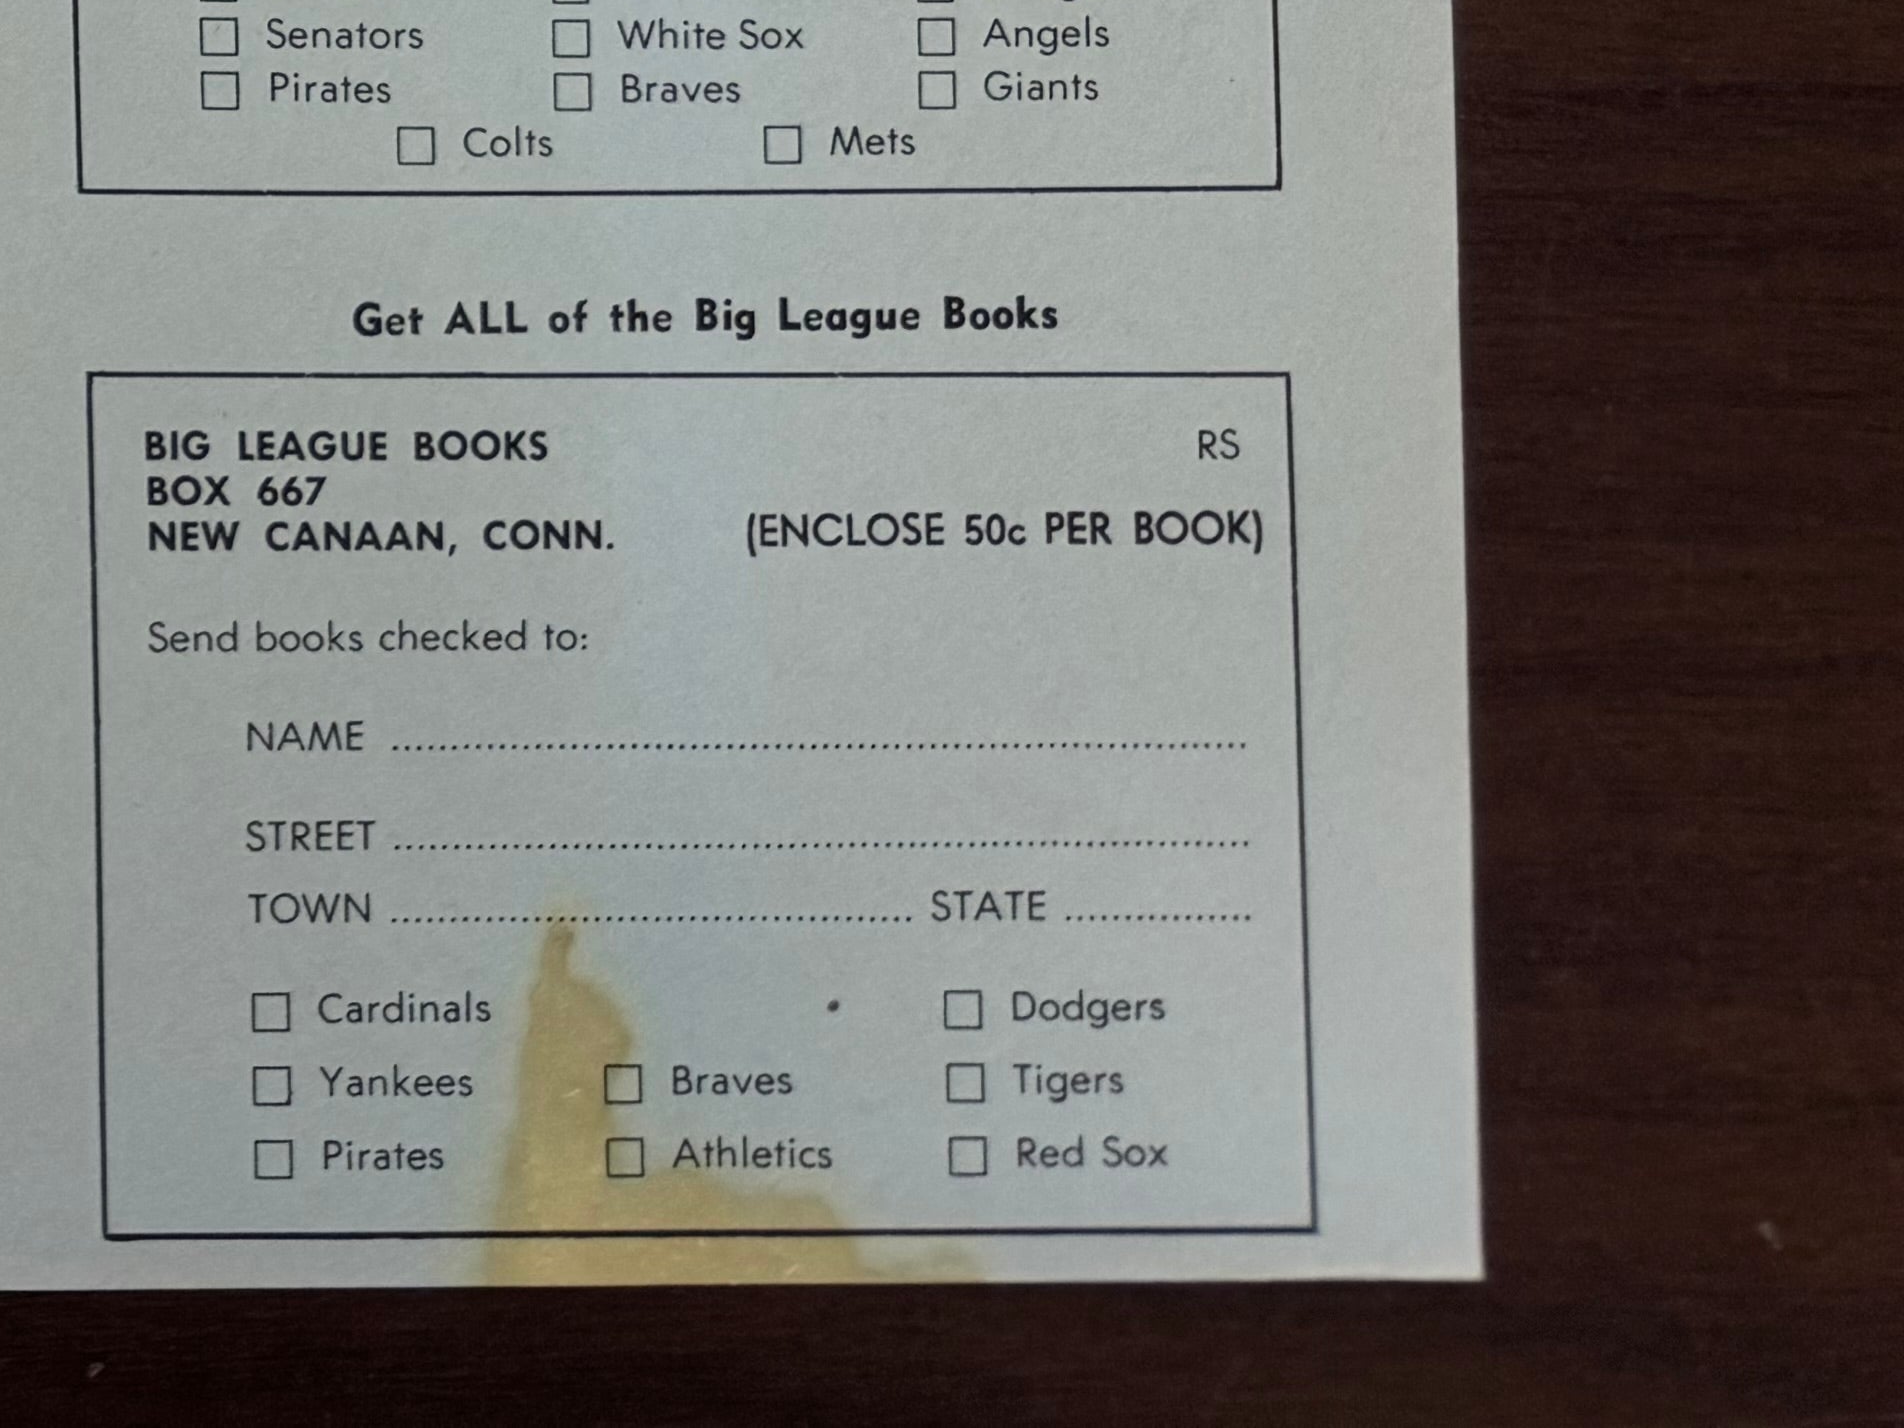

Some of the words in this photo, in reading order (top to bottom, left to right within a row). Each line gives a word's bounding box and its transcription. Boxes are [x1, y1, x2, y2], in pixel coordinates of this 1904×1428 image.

[266, 17, 424, 50] Senators
[616, 16, 727, 51] White
[738, 18, 805, 51] Sox
[982, 14, 1110, 57] Angels
[269, 71, 392, 104] Pirates
[621, 72, 742, 104] Braves
[983, 69, 1100, 102] Giants
[462, 124, 554, 159] Colts
[829, 125, 917, 157] Mets
[352, 300, 425, 338] Get
[443, 299, 529, 336] ALL
[547, 298, 589, 335] of
[608, 297, 673, 334] the
[694, 296, 757, 342] Big
[778, 296, 921, 340] League
[943, 294, 1059, 331] Books
[144, 429, 211, 462] BIG
[237, 429, 388, 462] LEAGUE
[413, 429, 549, 462] BOOKS
[1197, 427, 1241, 461] RS
[146, 474, 232, 507] BOX
[256, 475, 328, 508] 667
[148, 520, 241, 553] NEW
[264, 520, 458, 558] CANAAN,
[482, 518, 615, 552] CONN.
[746, 511, 946, 559] (ENCLOSE
[964, 512, 1028, 547] 50c
[1044, 510, 1113, 546] PER
[1133, 508, 1264, 556] BOOK)
[147, 619, 239, 654] Send
[255, 619, 365, 654] books
[378, 618, 528, 653] checked
[543, 623, 588, 652] to:
[246, 719, 364, 752] NAME
[245, 819, 377, 853] STREET
[247, 891, 372, 925] TOWN
[930, 889, 1047, 923] STATE
[317, 989, 492, 1025] Cardinals
[1011, 988, 1167, 1030] Dodgers
[319, 1063, 474, 1098] Yankees
[671, 1064, 794, 1097] Braves
[1012, 1062, 1125, 1105] Tigers
[322, 1139, 445, 1172] Pirates
[671, 1134, 833, 1170] Athletics
[1016, 1133, 1085, 1169] Red
[1102, 1134, 1169, 1169] Sox
